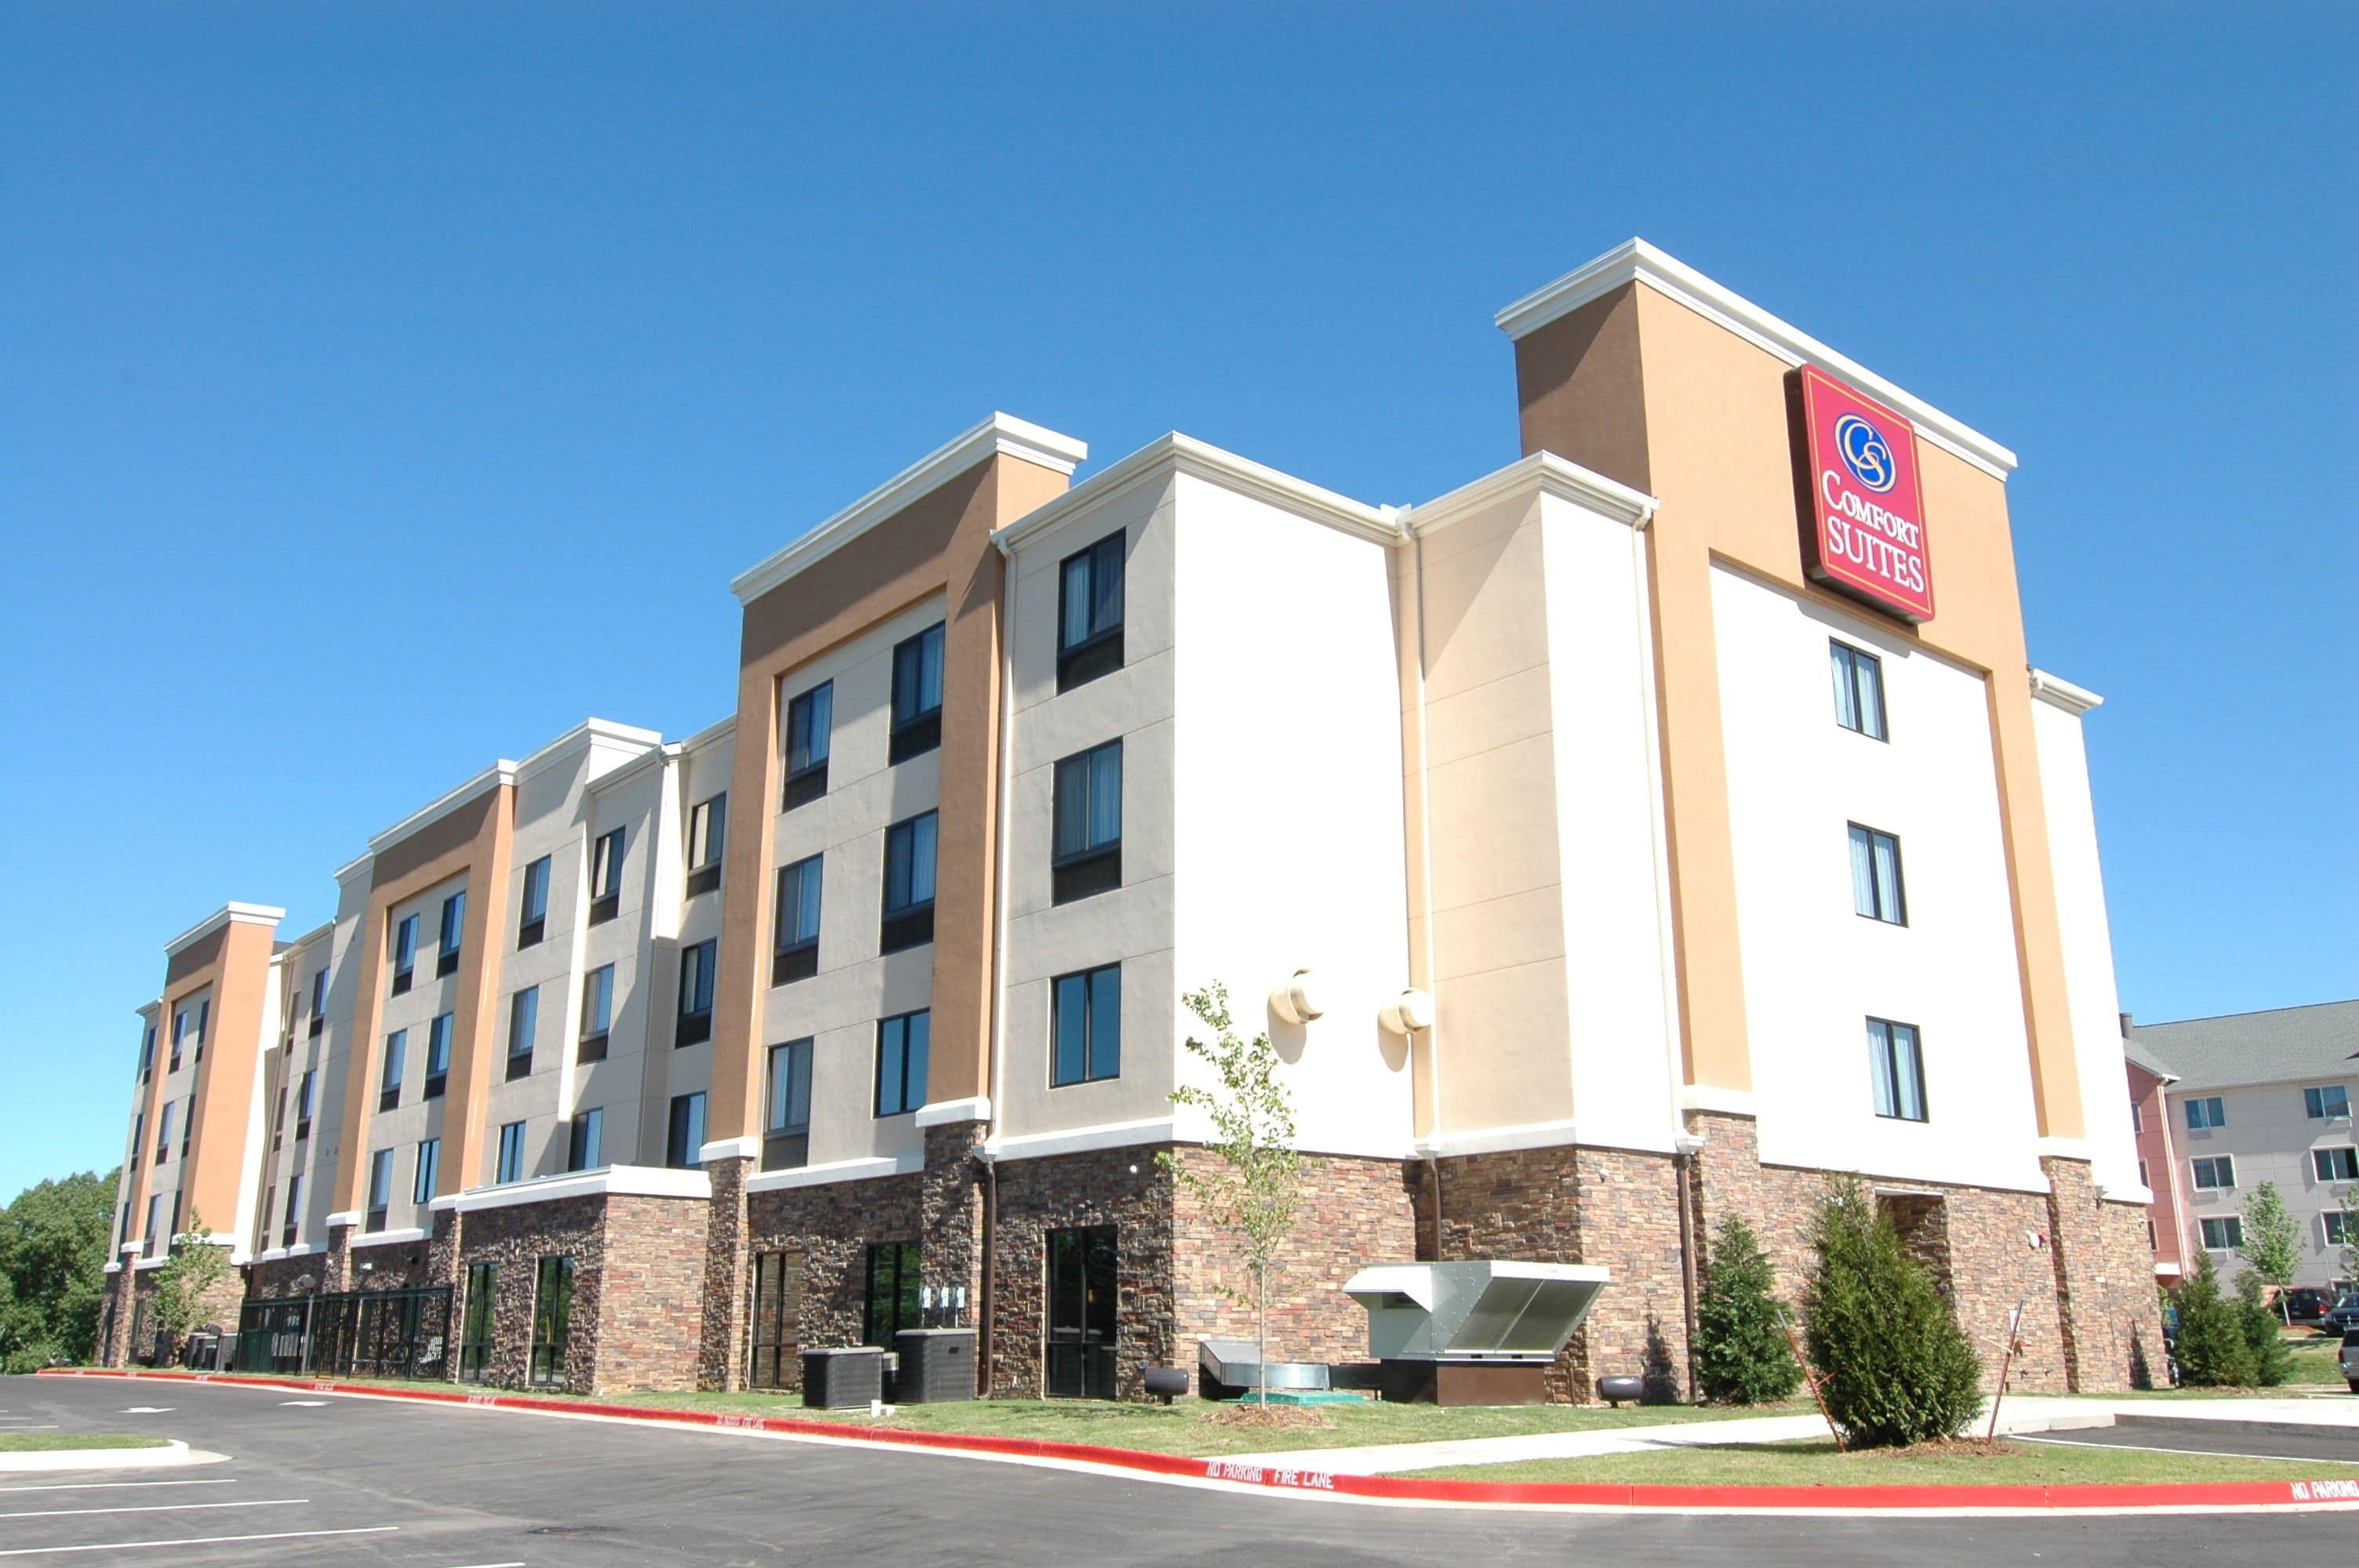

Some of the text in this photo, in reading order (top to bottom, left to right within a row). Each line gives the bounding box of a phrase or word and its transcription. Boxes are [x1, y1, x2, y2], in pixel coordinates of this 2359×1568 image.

[1822, 470, 1919, 549] COMFORT
[1827, 515, 1925, 593] SUITES
[1206, 1461, 1333, 1489] NO PARKING FIRE LANE
[2290, 1481, 2310, 1500] NO
